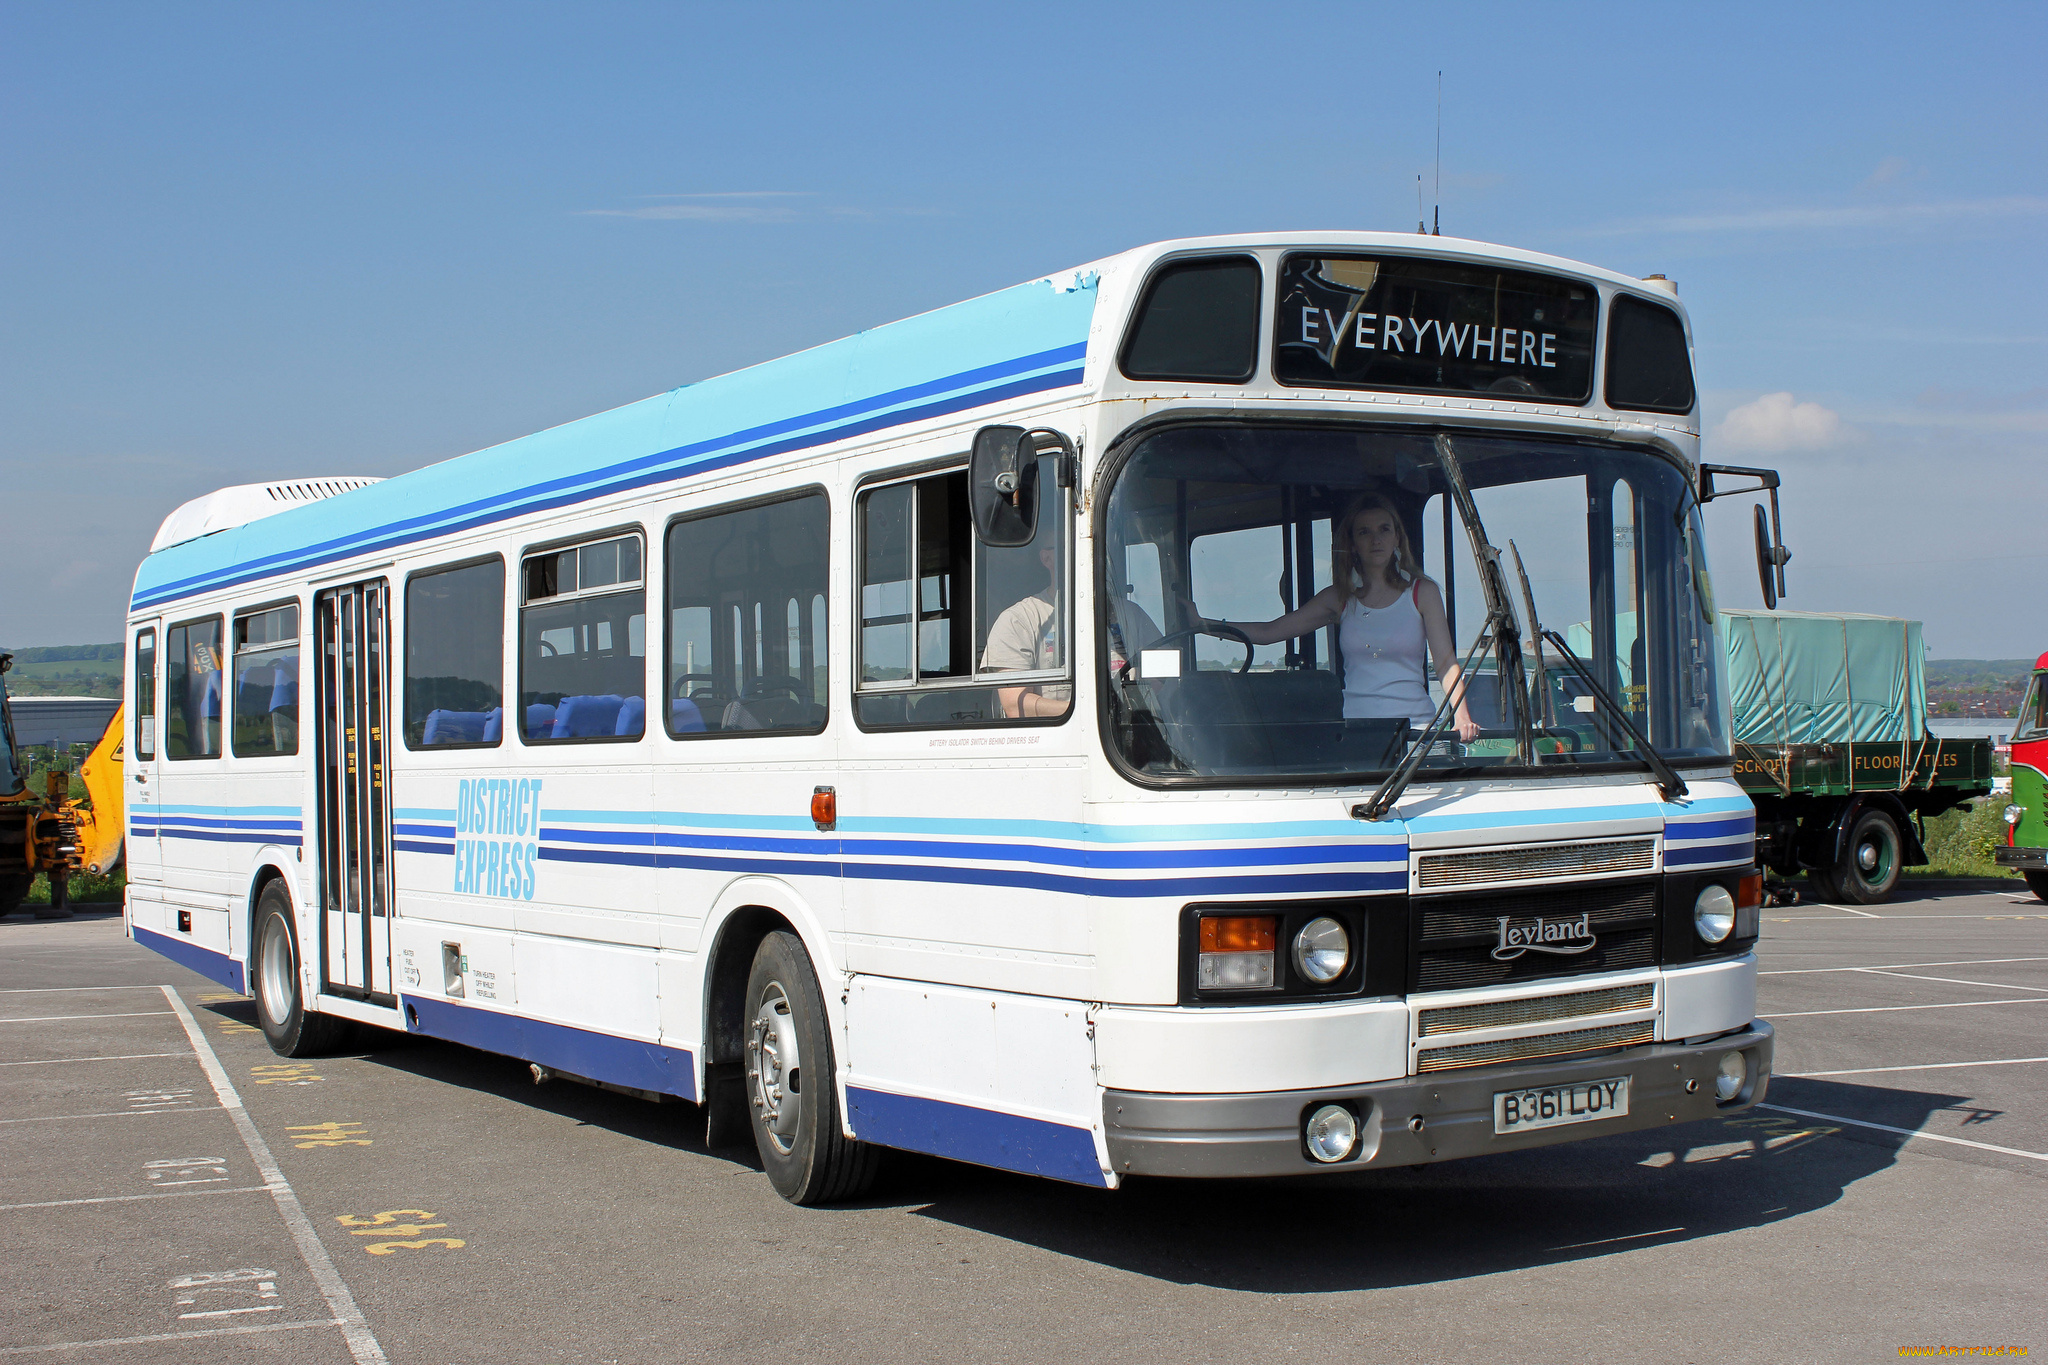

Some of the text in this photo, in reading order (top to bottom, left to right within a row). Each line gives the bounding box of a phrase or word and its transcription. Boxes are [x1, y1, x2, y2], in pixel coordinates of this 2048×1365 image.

[1301, 304, 1557, 368] EVERYWHERE
[929, 739, 947, 747] BATTERY
[970, 738, 988, 746] SWITCH
[989, 737, 1006, 745] BEHIND
[1007, 736, 1027, 744] DRIVERS
[1028, 735, 1040, 744] SEAT
[1855, 755, 1900, 770] FLOOR
[457, 778, 543, 837] DISTRICT
[454, 839, 537, 901] EXPRESS
[1492, 913, 1596, 960] Leyland
[482, 972, 496, 980] HEATER
[1503, 1082, 1620, 1126] B361 LOY
[284, 1121, 374, 1149] 344
[335, 1209, 467, 1256] 345
